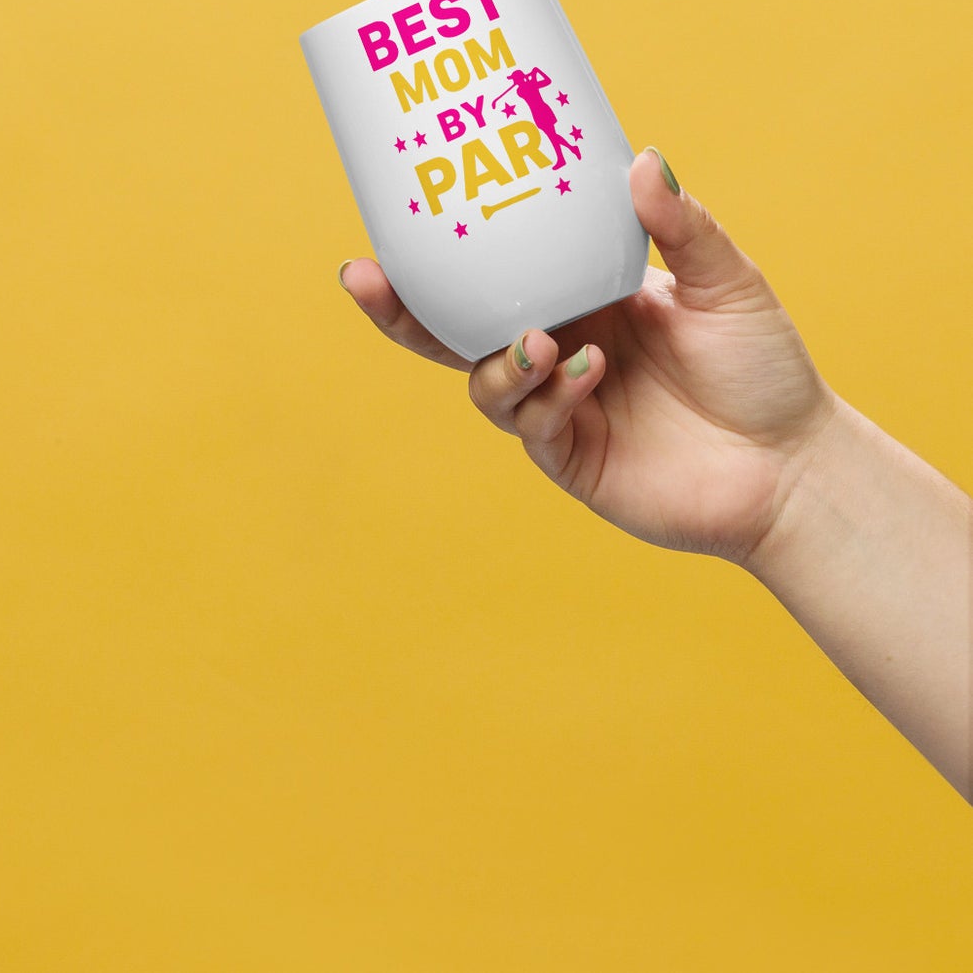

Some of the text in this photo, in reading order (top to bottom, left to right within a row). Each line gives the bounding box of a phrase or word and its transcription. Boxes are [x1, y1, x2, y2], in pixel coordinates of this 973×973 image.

[389, 27, 516, 114] MOM
[436, 95, 486, 142] BY
[414, 120, 553, 216] PAR
